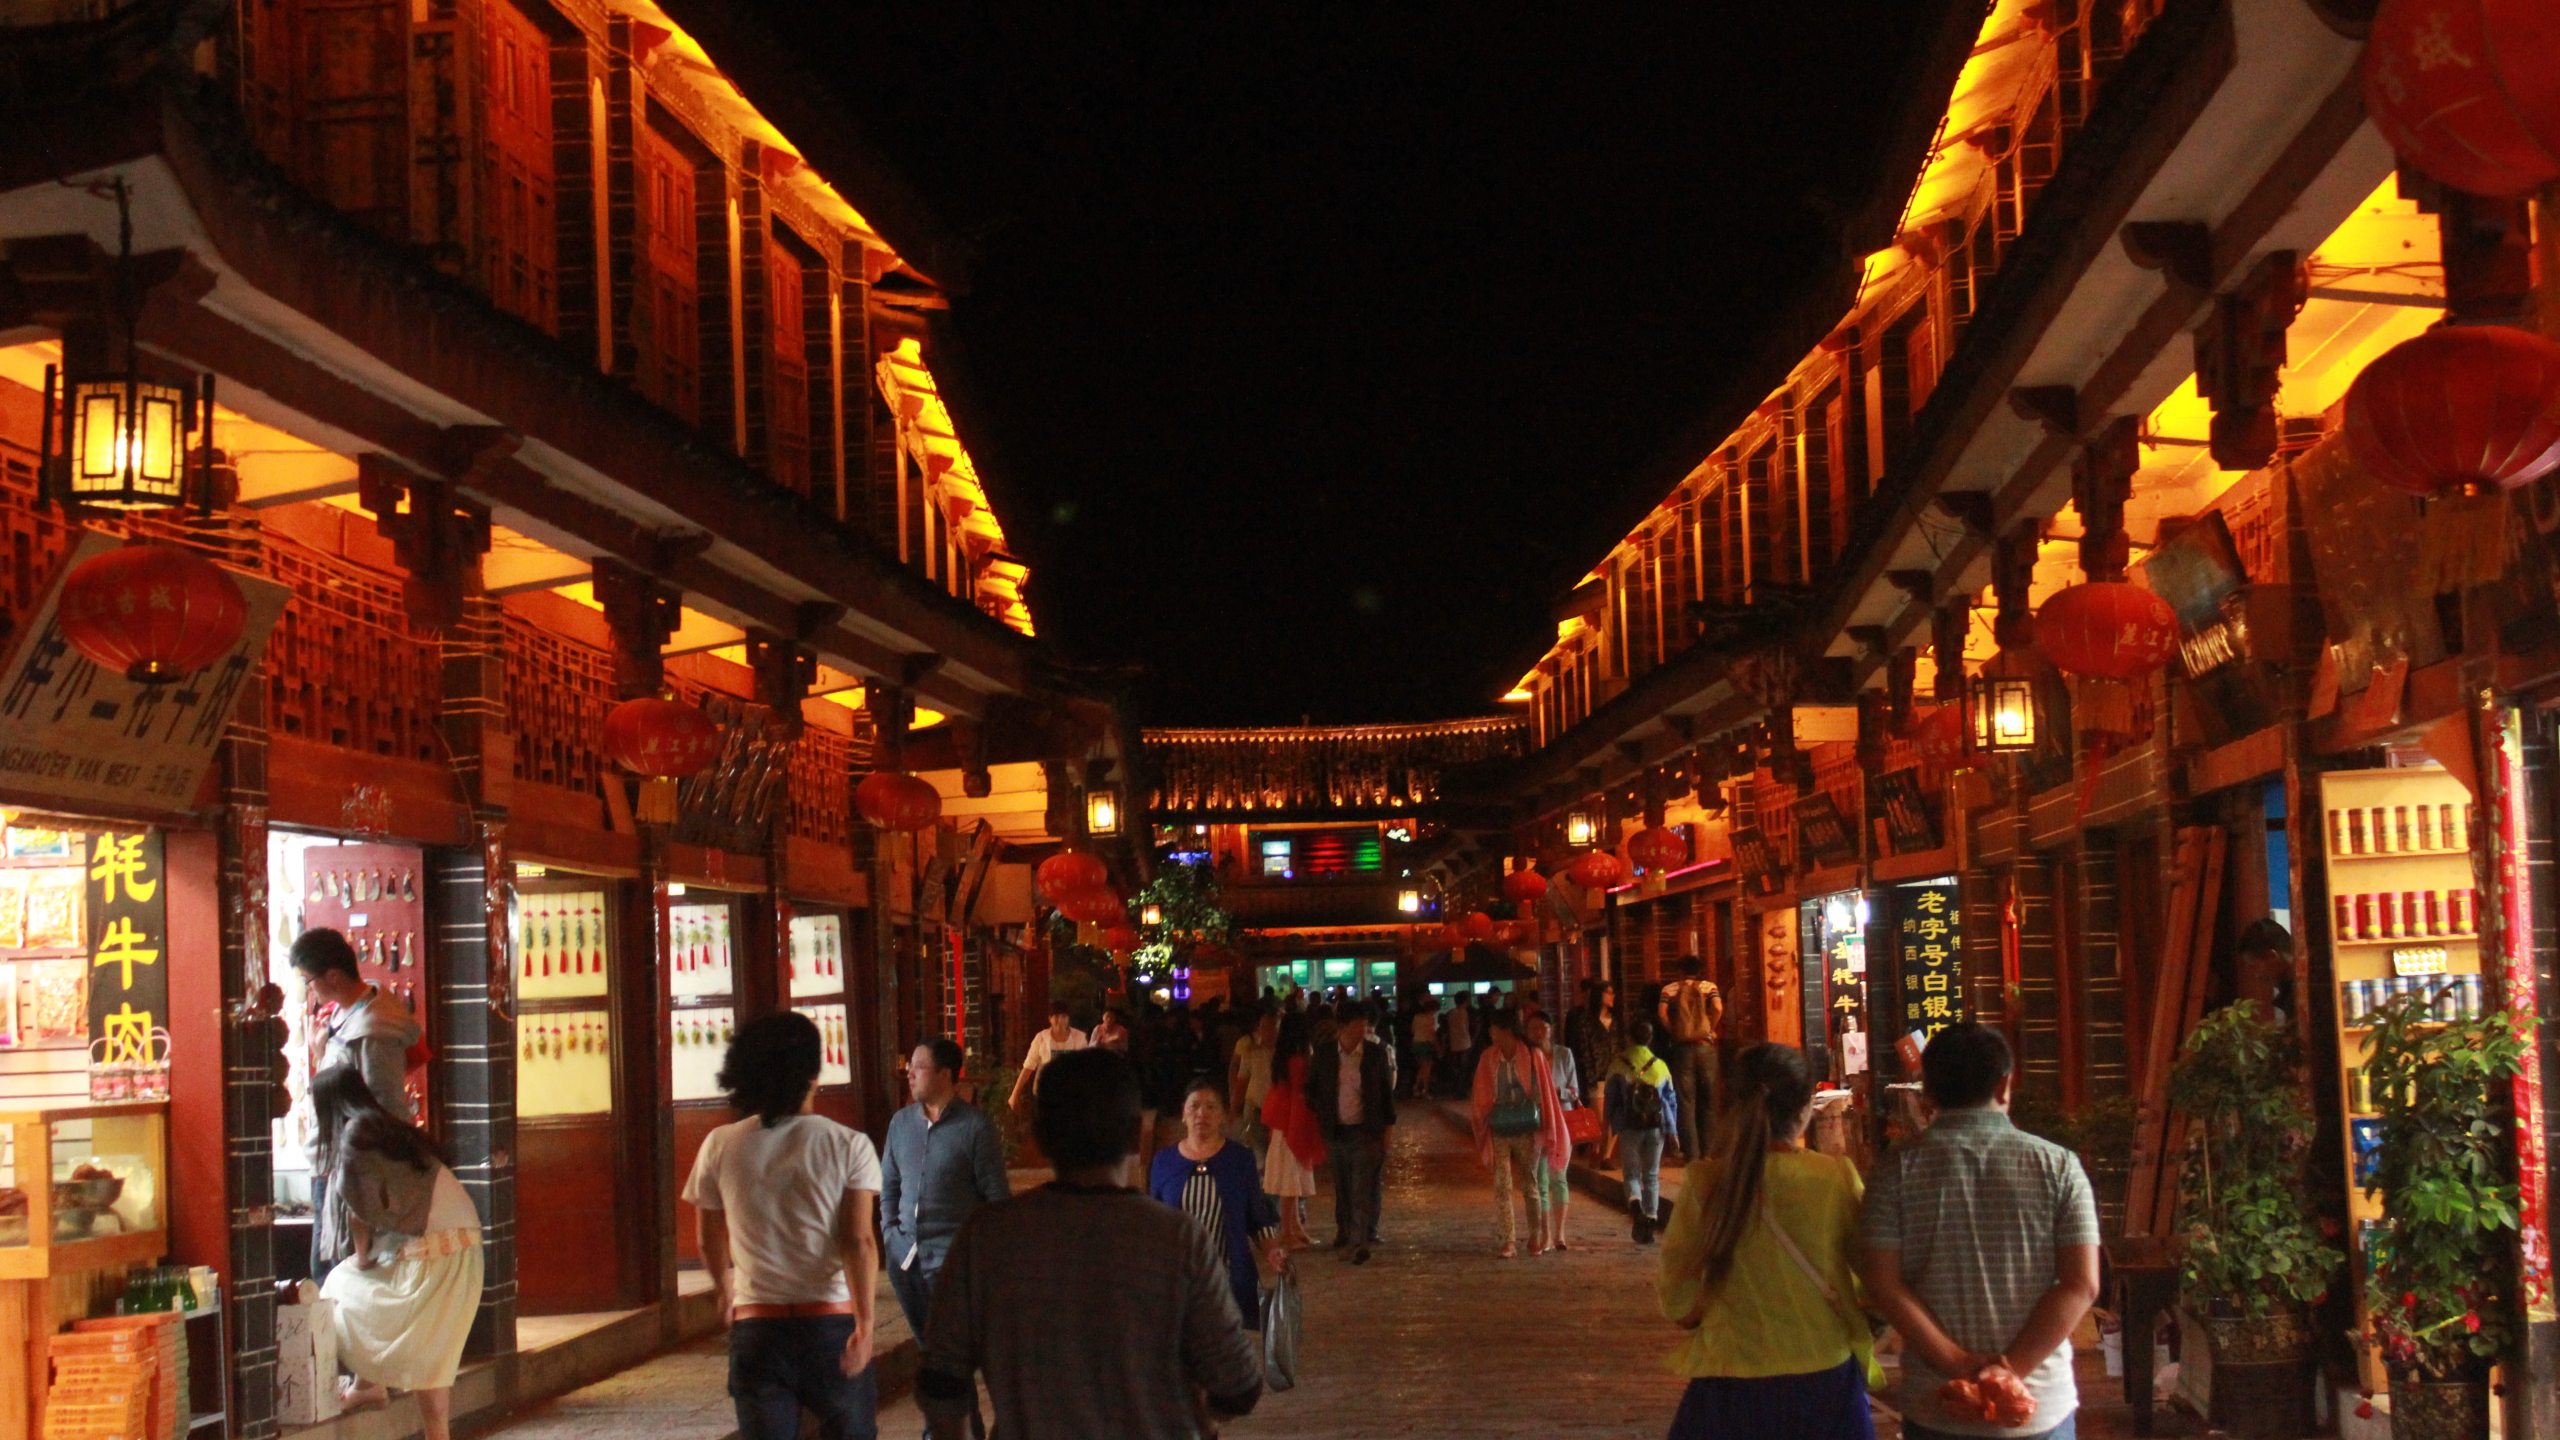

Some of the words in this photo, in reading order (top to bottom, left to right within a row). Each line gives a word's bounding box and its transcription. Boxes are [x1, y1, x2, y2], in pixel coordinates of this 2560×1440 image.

[67, 583, 176, 622] 江古城
[74, 759, 103, 783] YAK
[90, 832, 159, 1064] 牦牛肉
[1903, 917, 1920, 1019] 纳西银器
